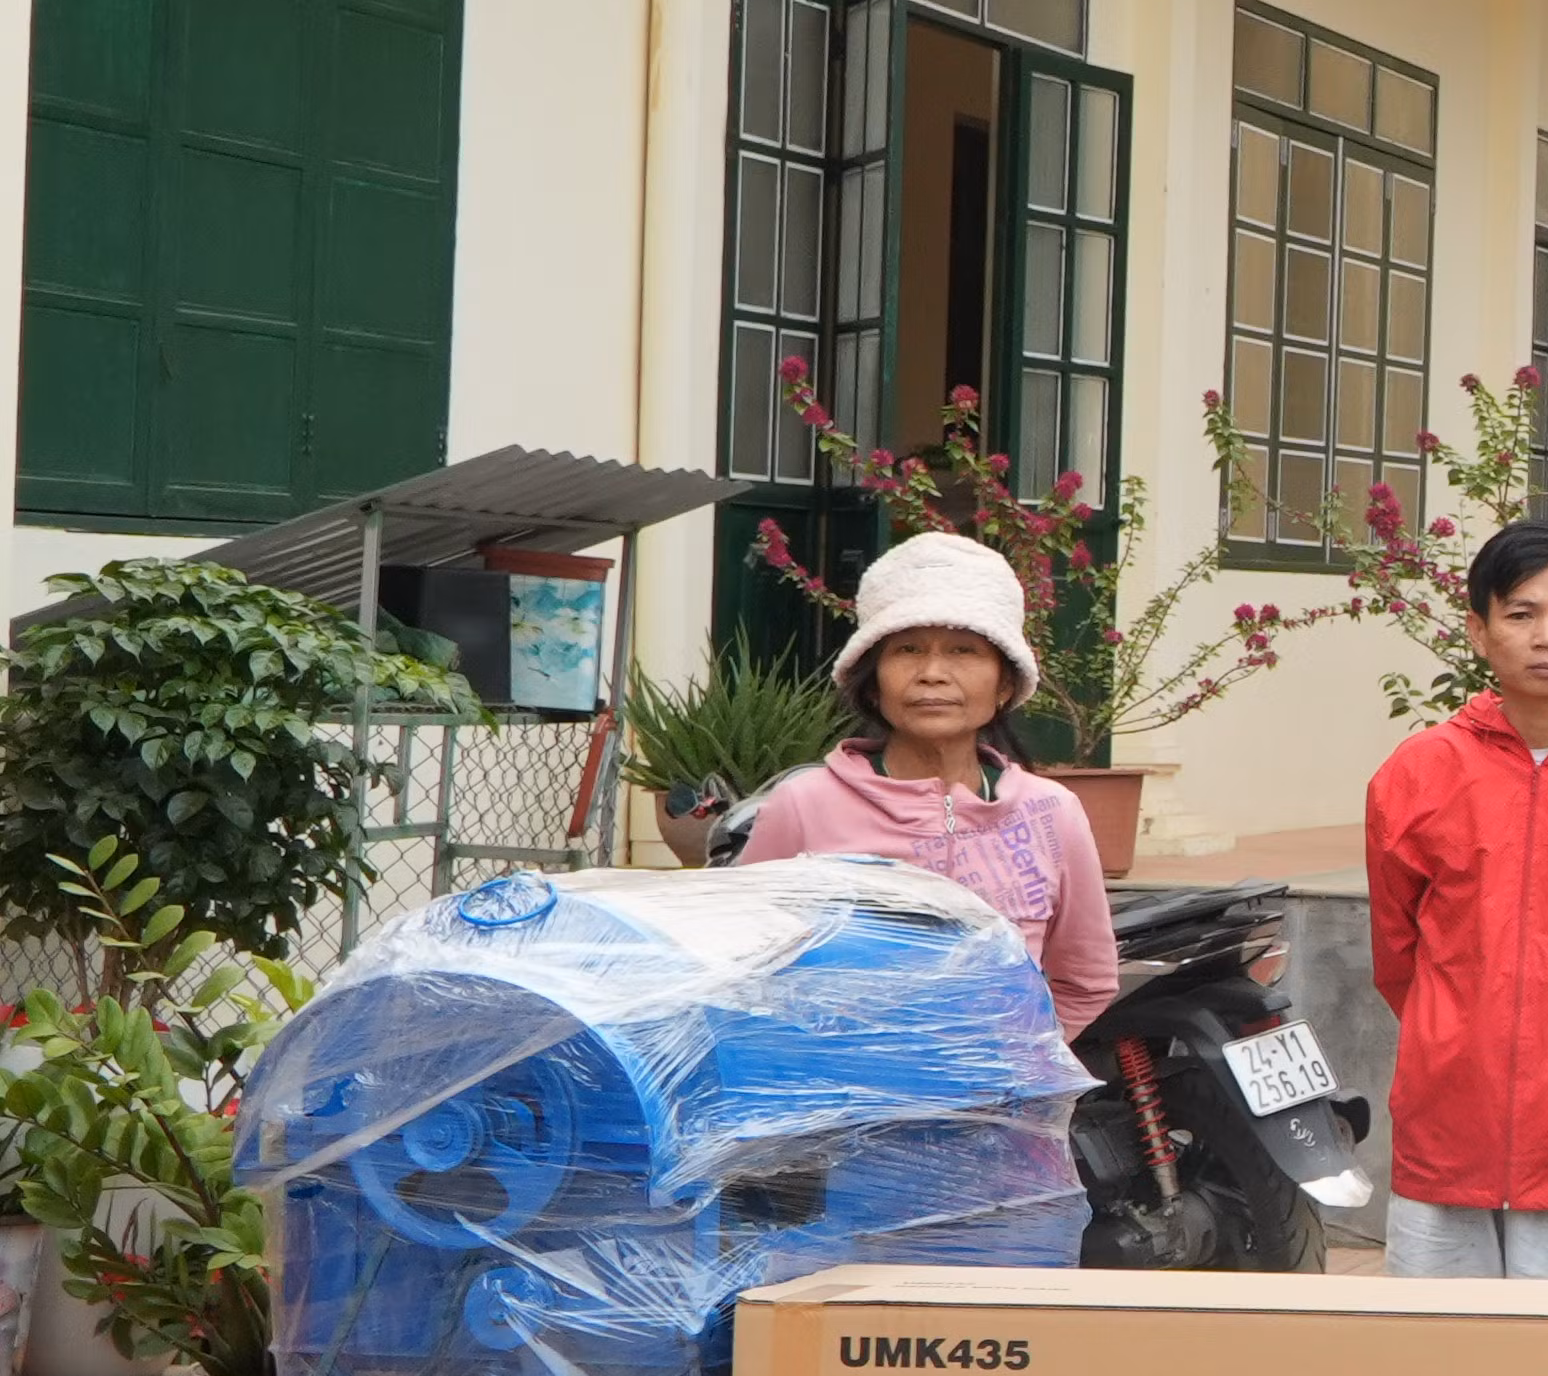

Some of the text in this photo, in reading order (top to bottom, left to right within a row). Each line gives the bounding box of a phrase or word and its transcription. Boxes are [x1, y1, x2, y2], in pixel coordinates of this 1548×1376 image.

[1001, 821, 1048, 919] Berlin
[1249, 1060, 1330, 1109] 256.19
[840, 1336, 1030, 1370] UMK435
